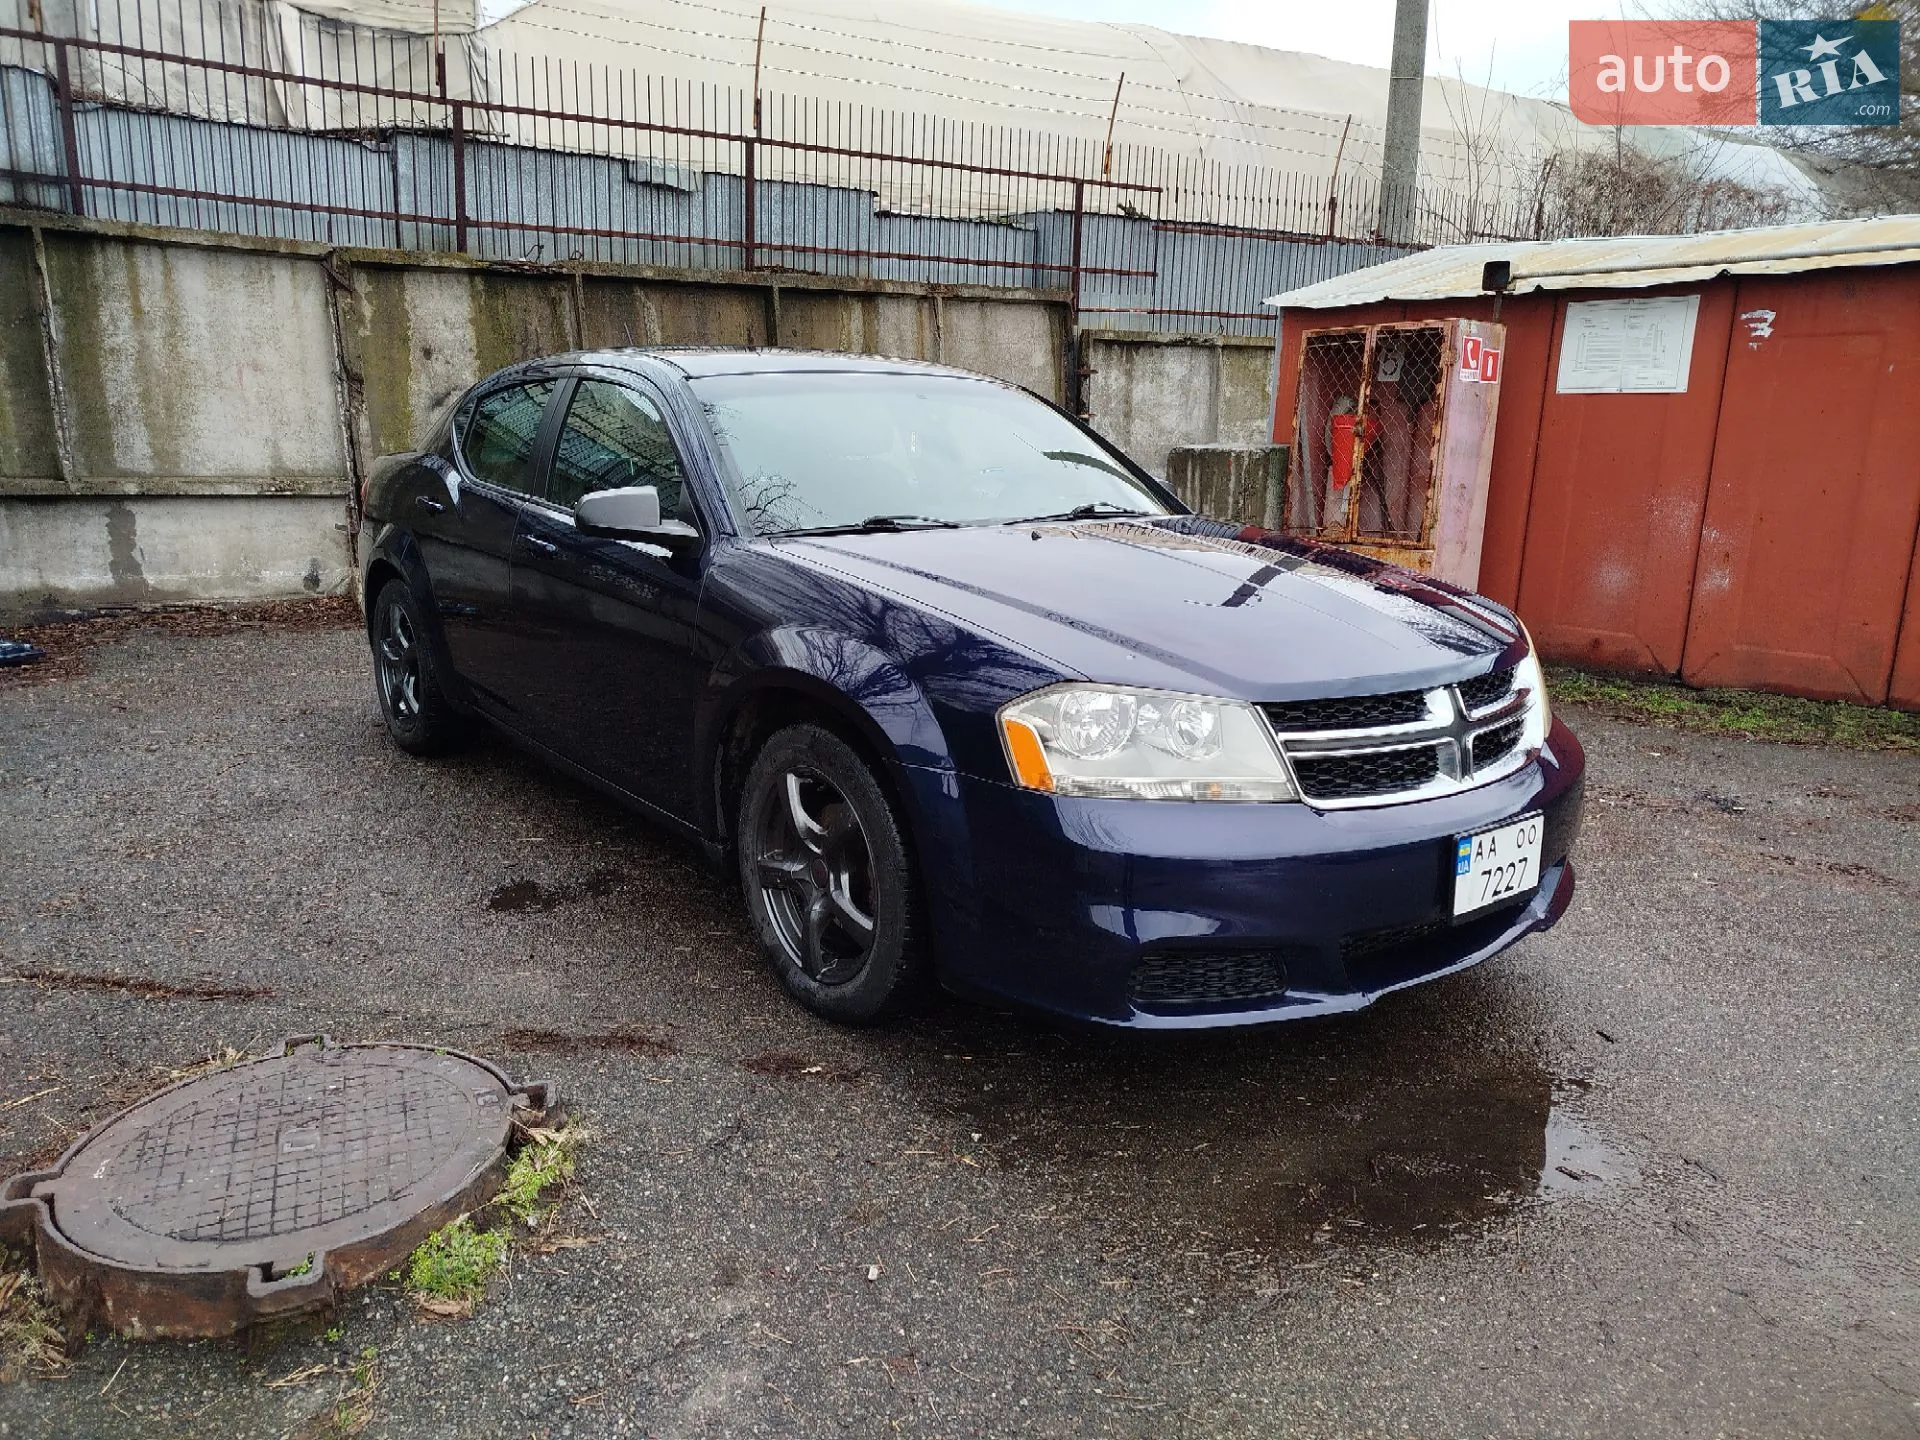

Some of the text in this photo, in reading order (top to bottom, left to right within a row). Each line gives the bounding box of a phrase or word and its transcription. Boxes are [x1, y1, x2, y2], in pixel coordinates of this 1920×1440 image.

[1474, 835, 1497, 862] AA
[1457, 860, 1470, 874] UA
[1481, 857, 1528, 902] 7227
